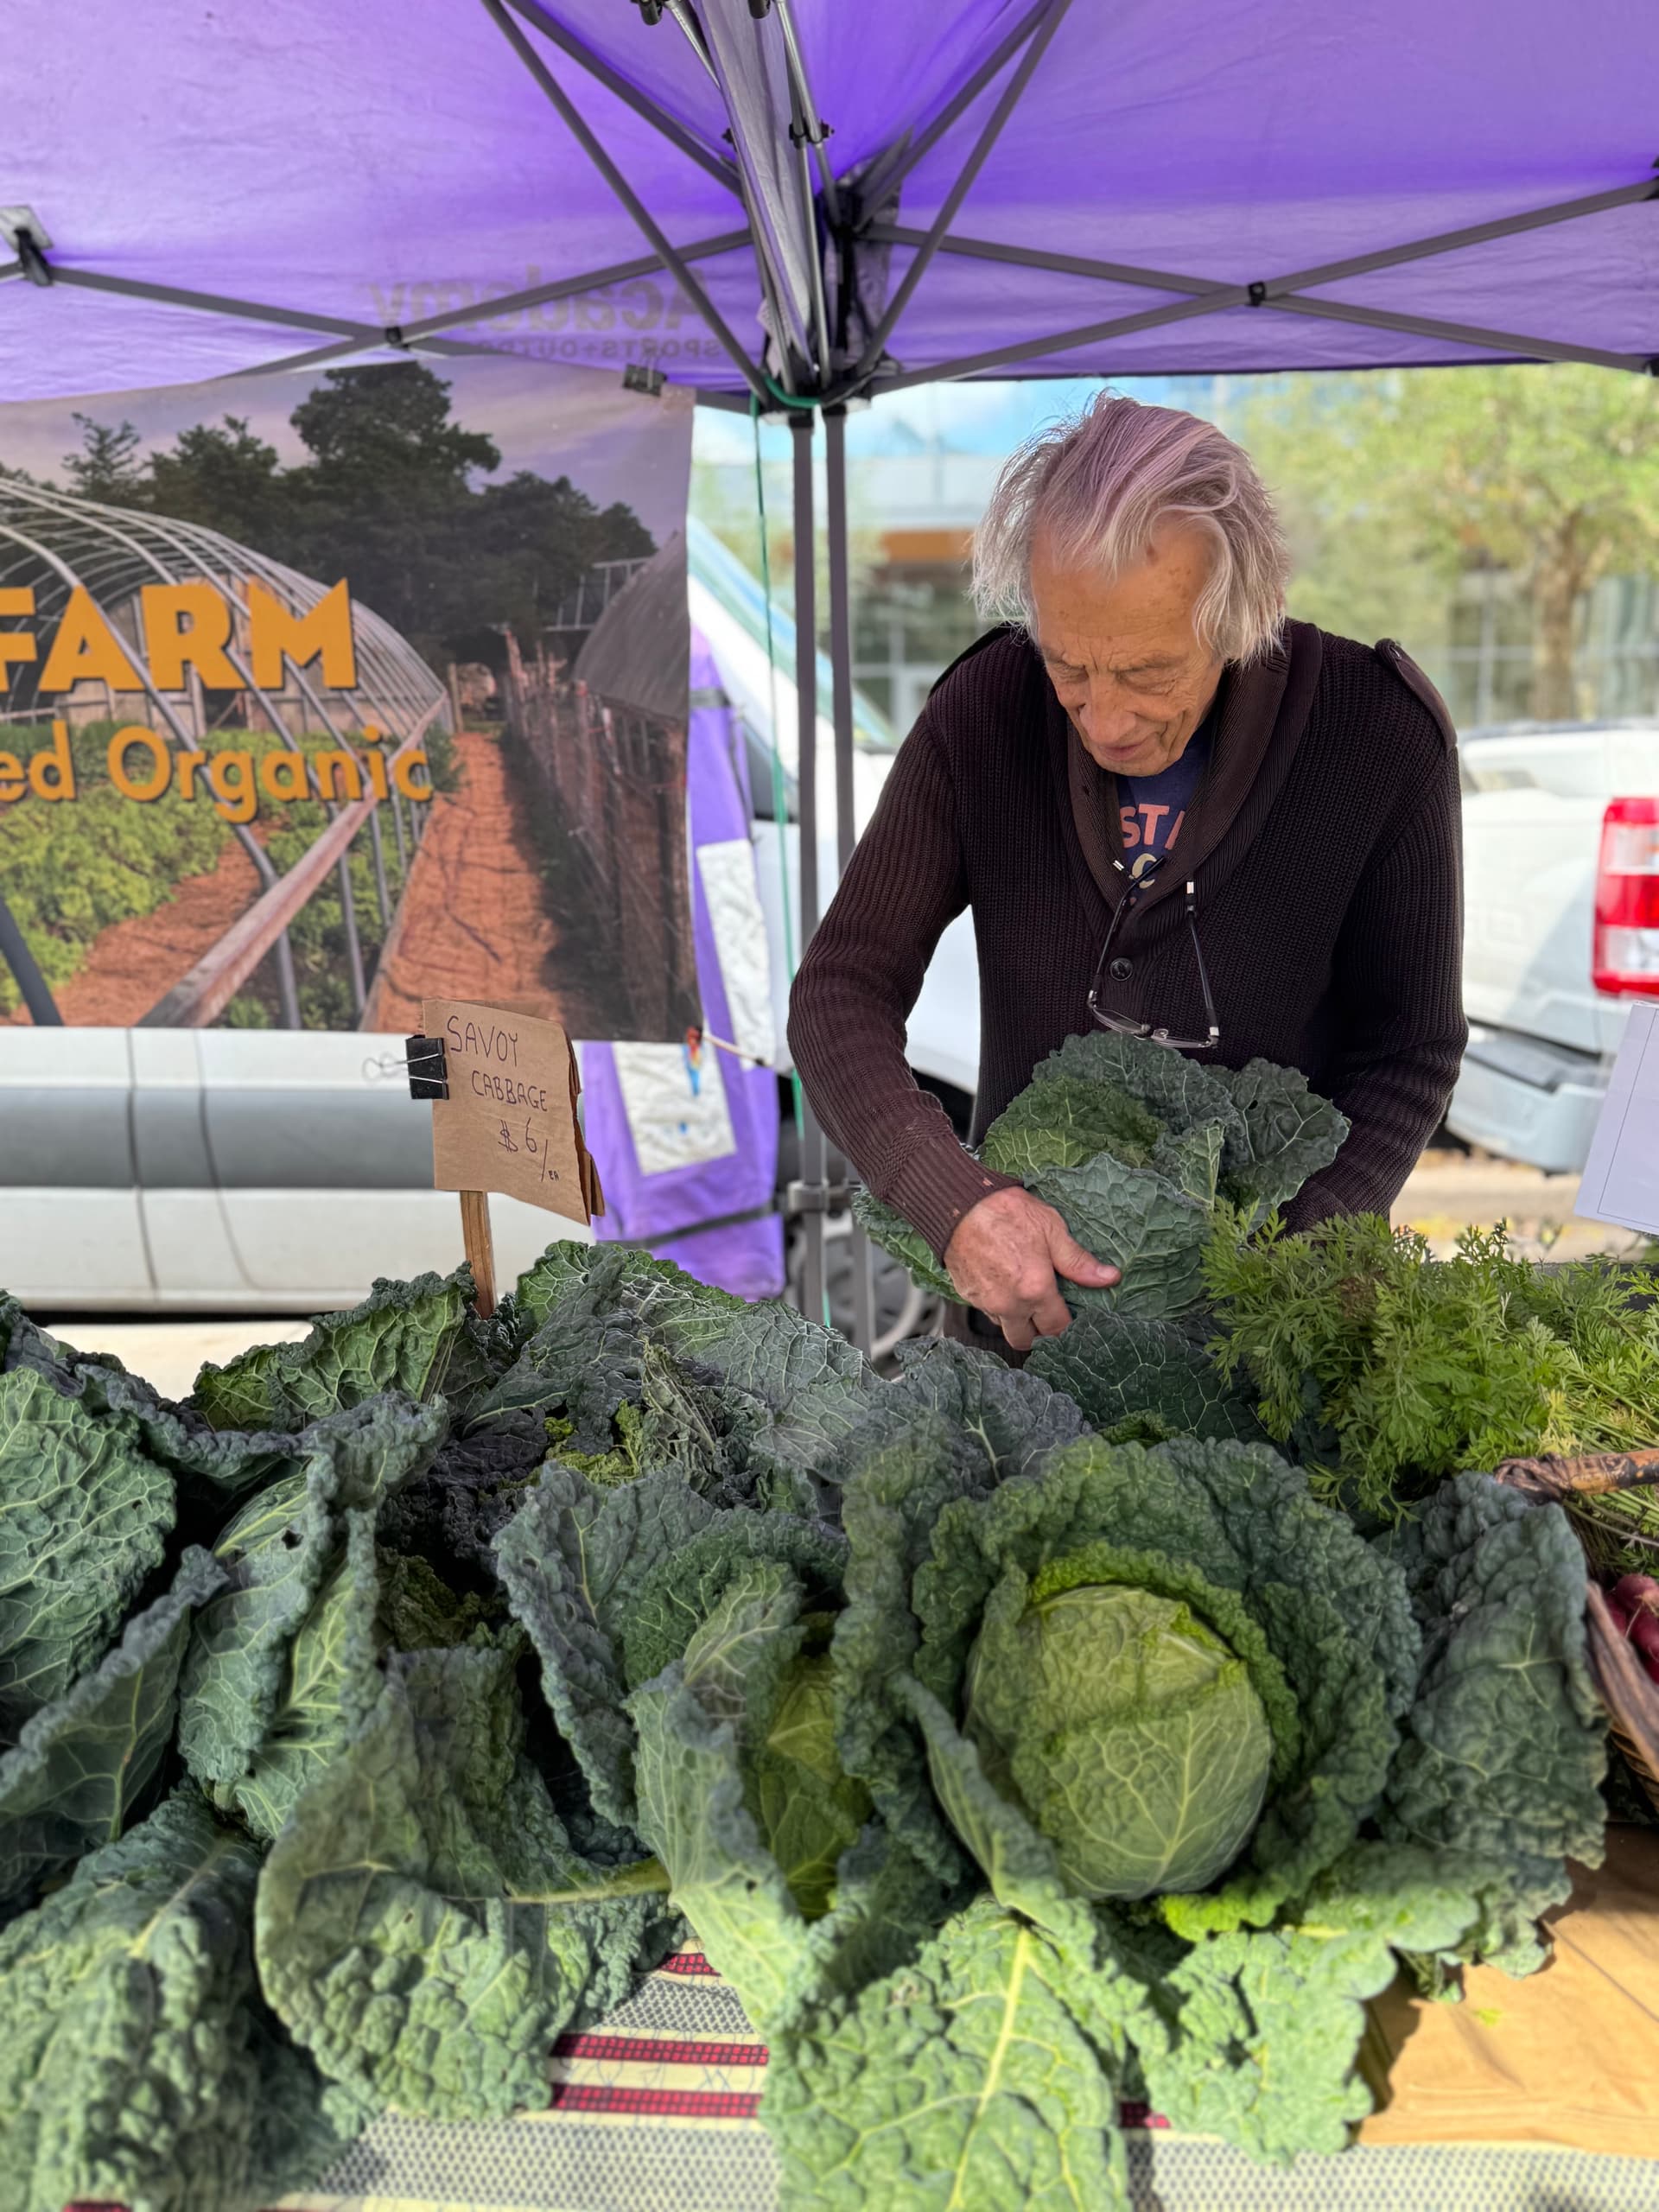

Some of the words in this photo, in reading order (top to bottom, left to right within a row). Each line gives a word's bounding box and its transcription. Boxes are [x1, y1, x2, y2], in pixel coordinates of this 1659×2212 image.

[0, 578, 357, 691] FARM
[107, 724, 434, 823] Organic
[447, 1015, 518, 1067] SAVOY
[471, 1070, 548, 1112] CABBAGE
